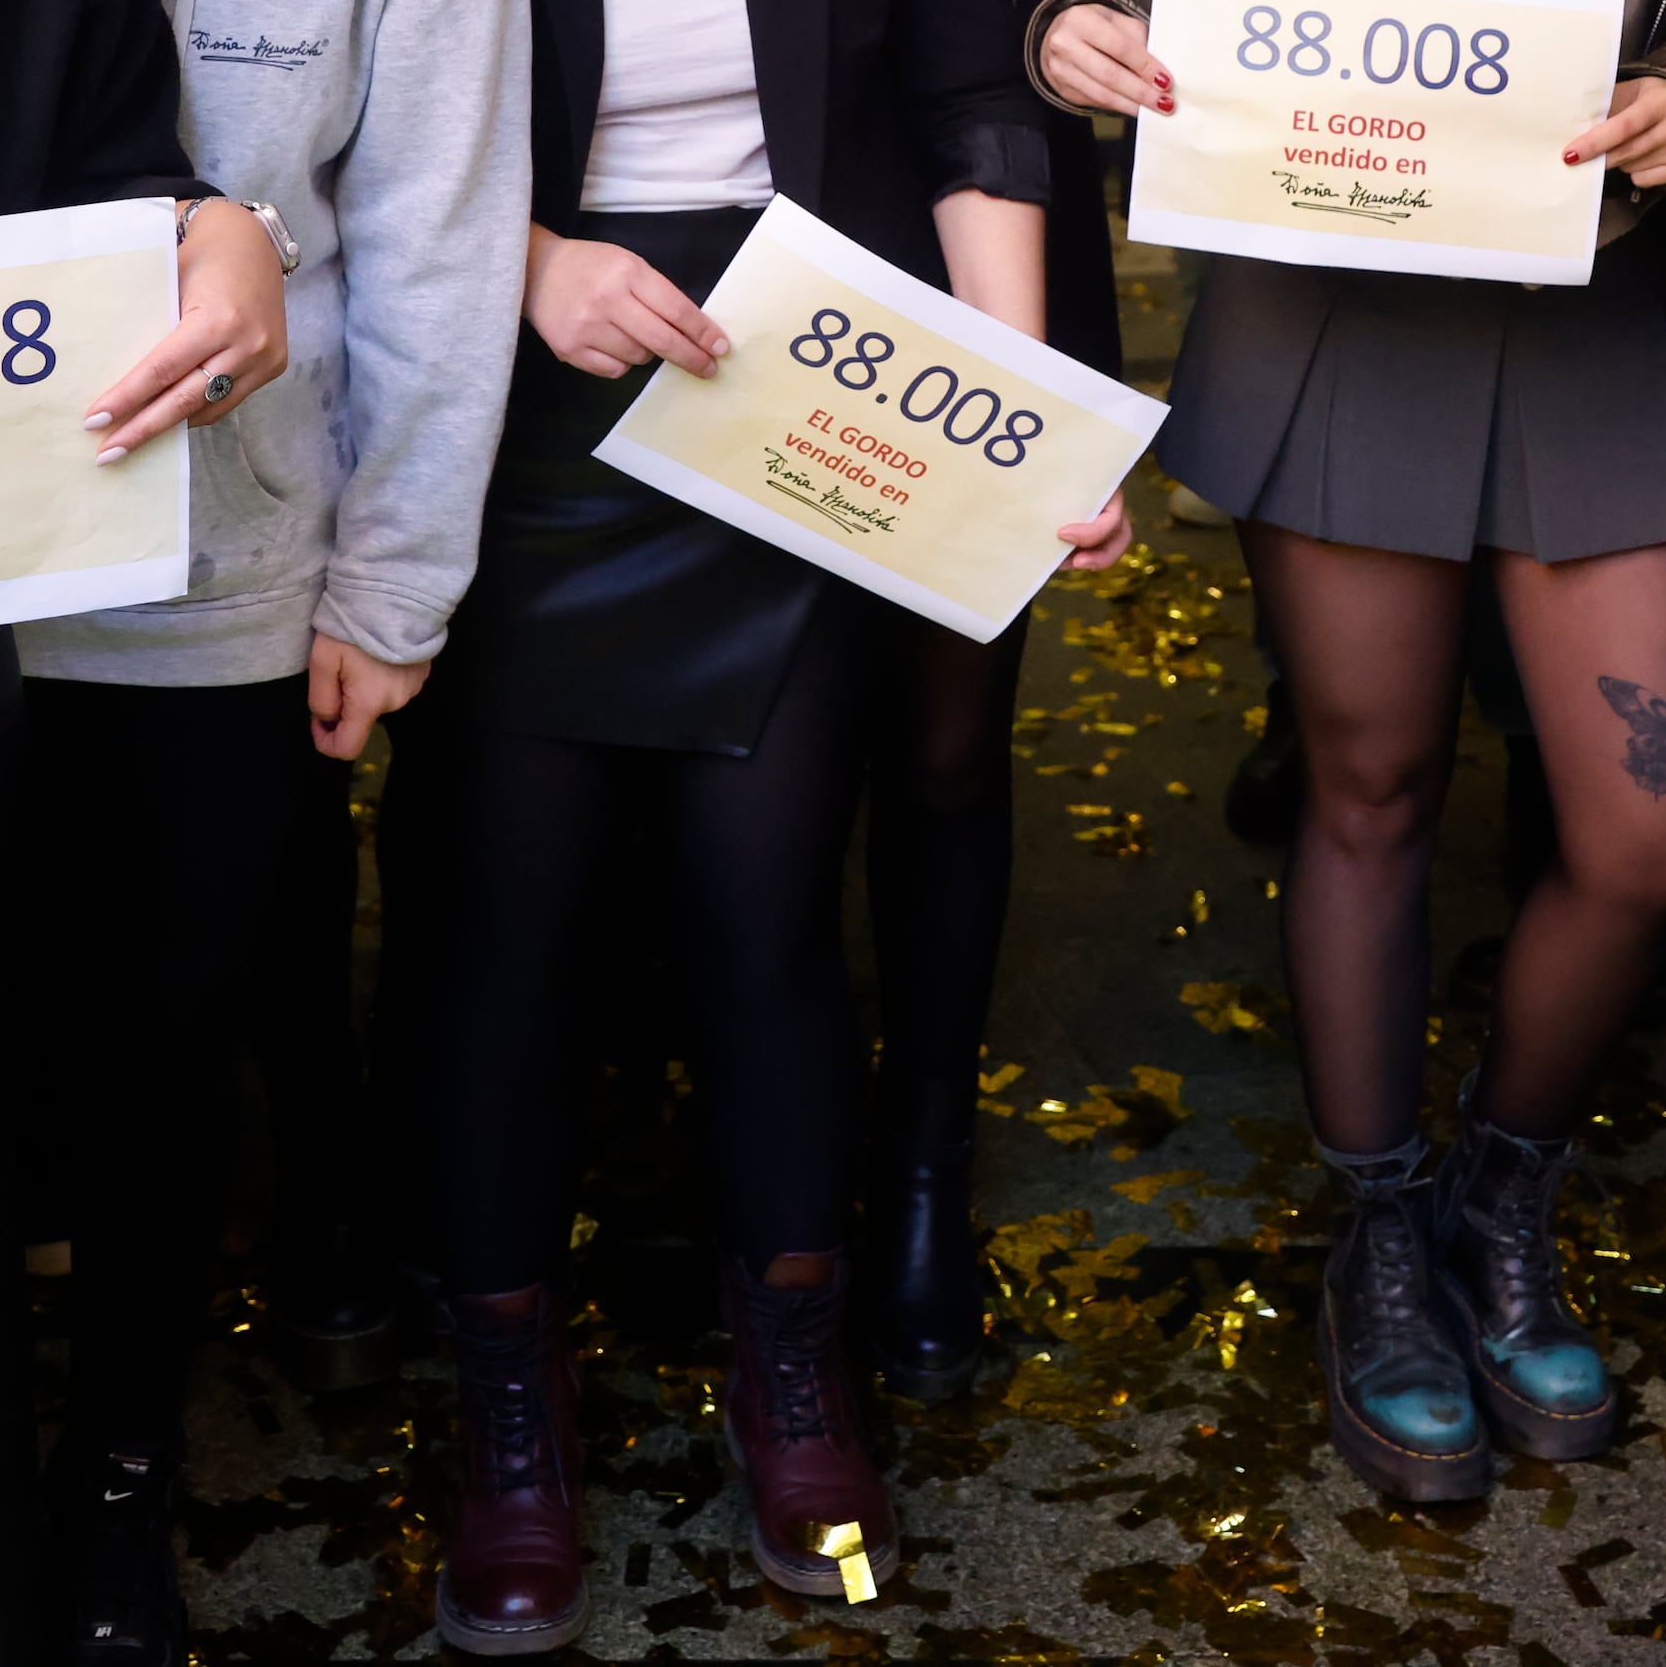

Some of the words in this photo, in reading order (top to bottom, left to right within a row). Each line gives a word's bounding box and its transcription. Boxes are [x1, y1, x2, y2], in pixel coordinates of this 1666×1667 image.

[1236, 4, 1512, 96] 88.008
[1283, 144, 1389, 174] vendido
[1395, 150, 1428, 176] en
[1291, 109, 1320, 133] EL
[1327, 114, 1428, 143] GORDO
[788, 308, 1045, 469] 88.008
[783, 430, 879, 498] vendido
[879, 476, 911, 507] en
[806, 408, 836, 436] EL
[836, 425, 929, 482] GORDO
